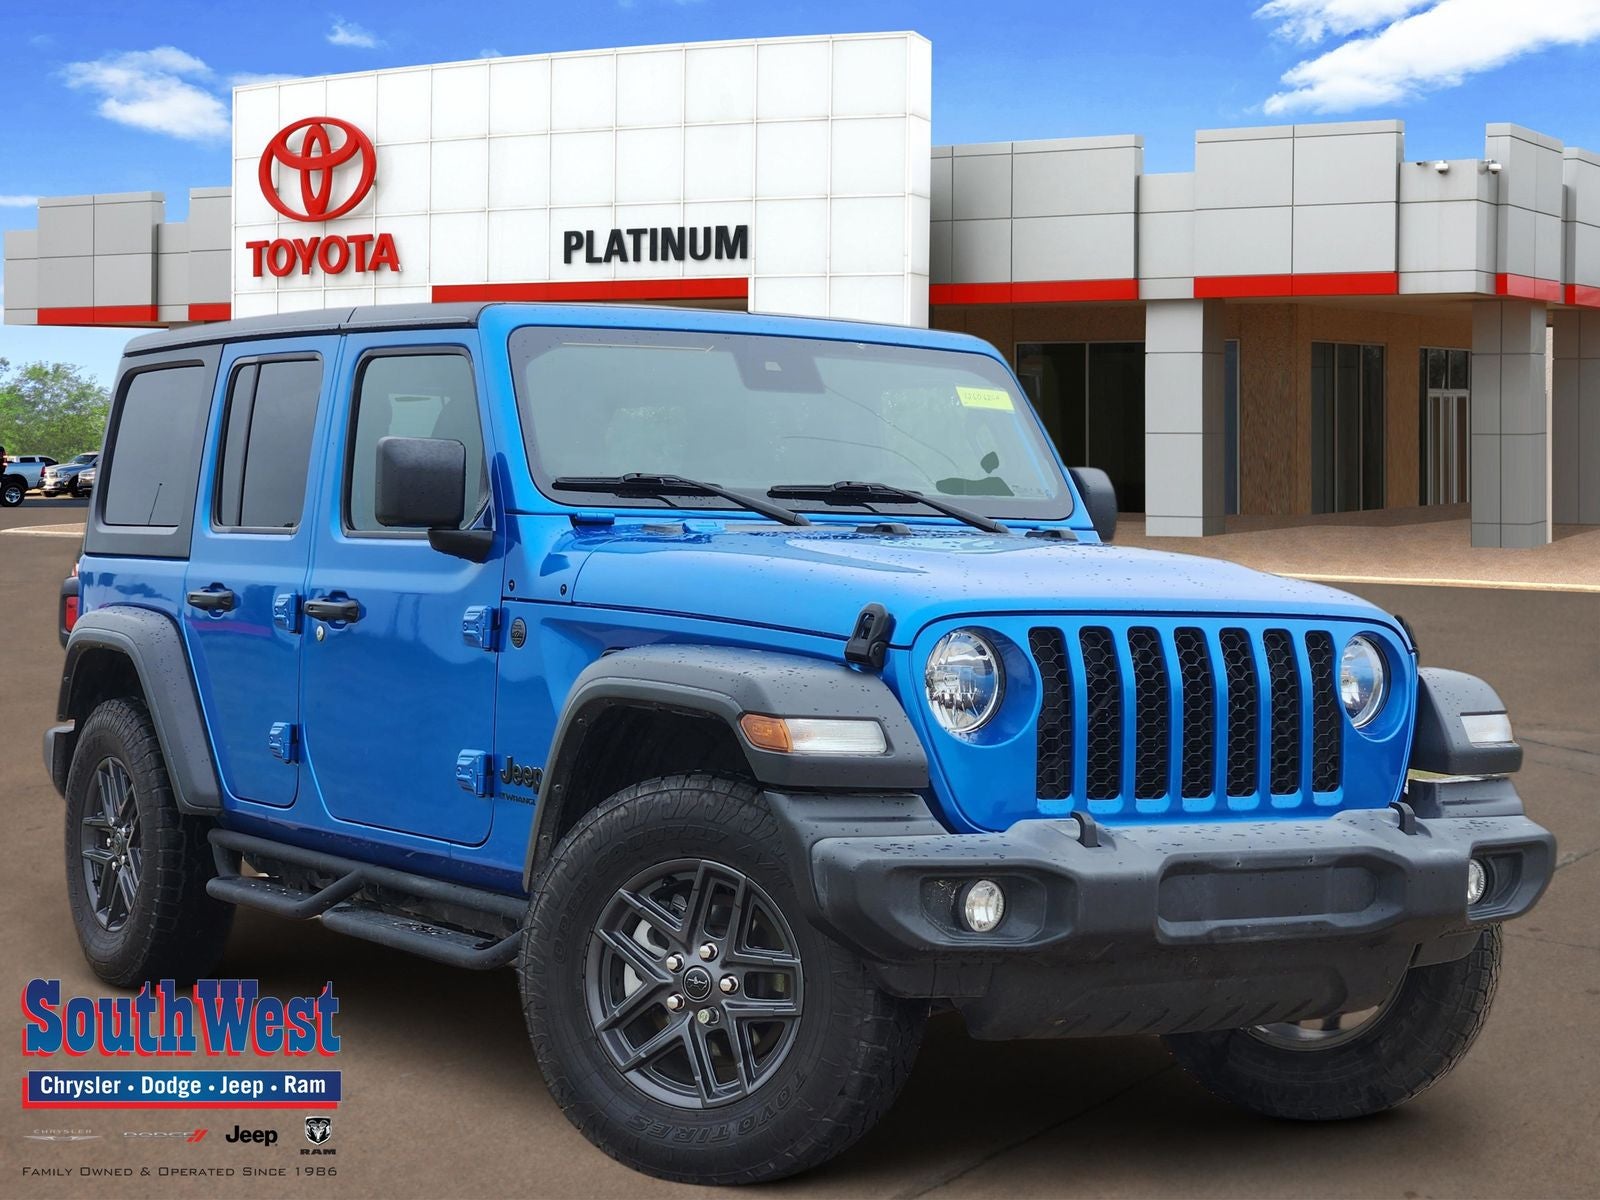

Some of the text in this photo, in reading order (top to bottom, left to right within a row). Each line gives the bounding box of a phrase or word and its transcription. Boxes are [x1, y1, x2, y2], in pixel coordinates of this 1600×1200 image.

[246, 233, 402, 278] TOYOTA
[563, 224, 749, 265] PLATINUM
[500, 755, 544, 795] Jeep
[625, 1069, 807, 1144] TOYO TIRES
